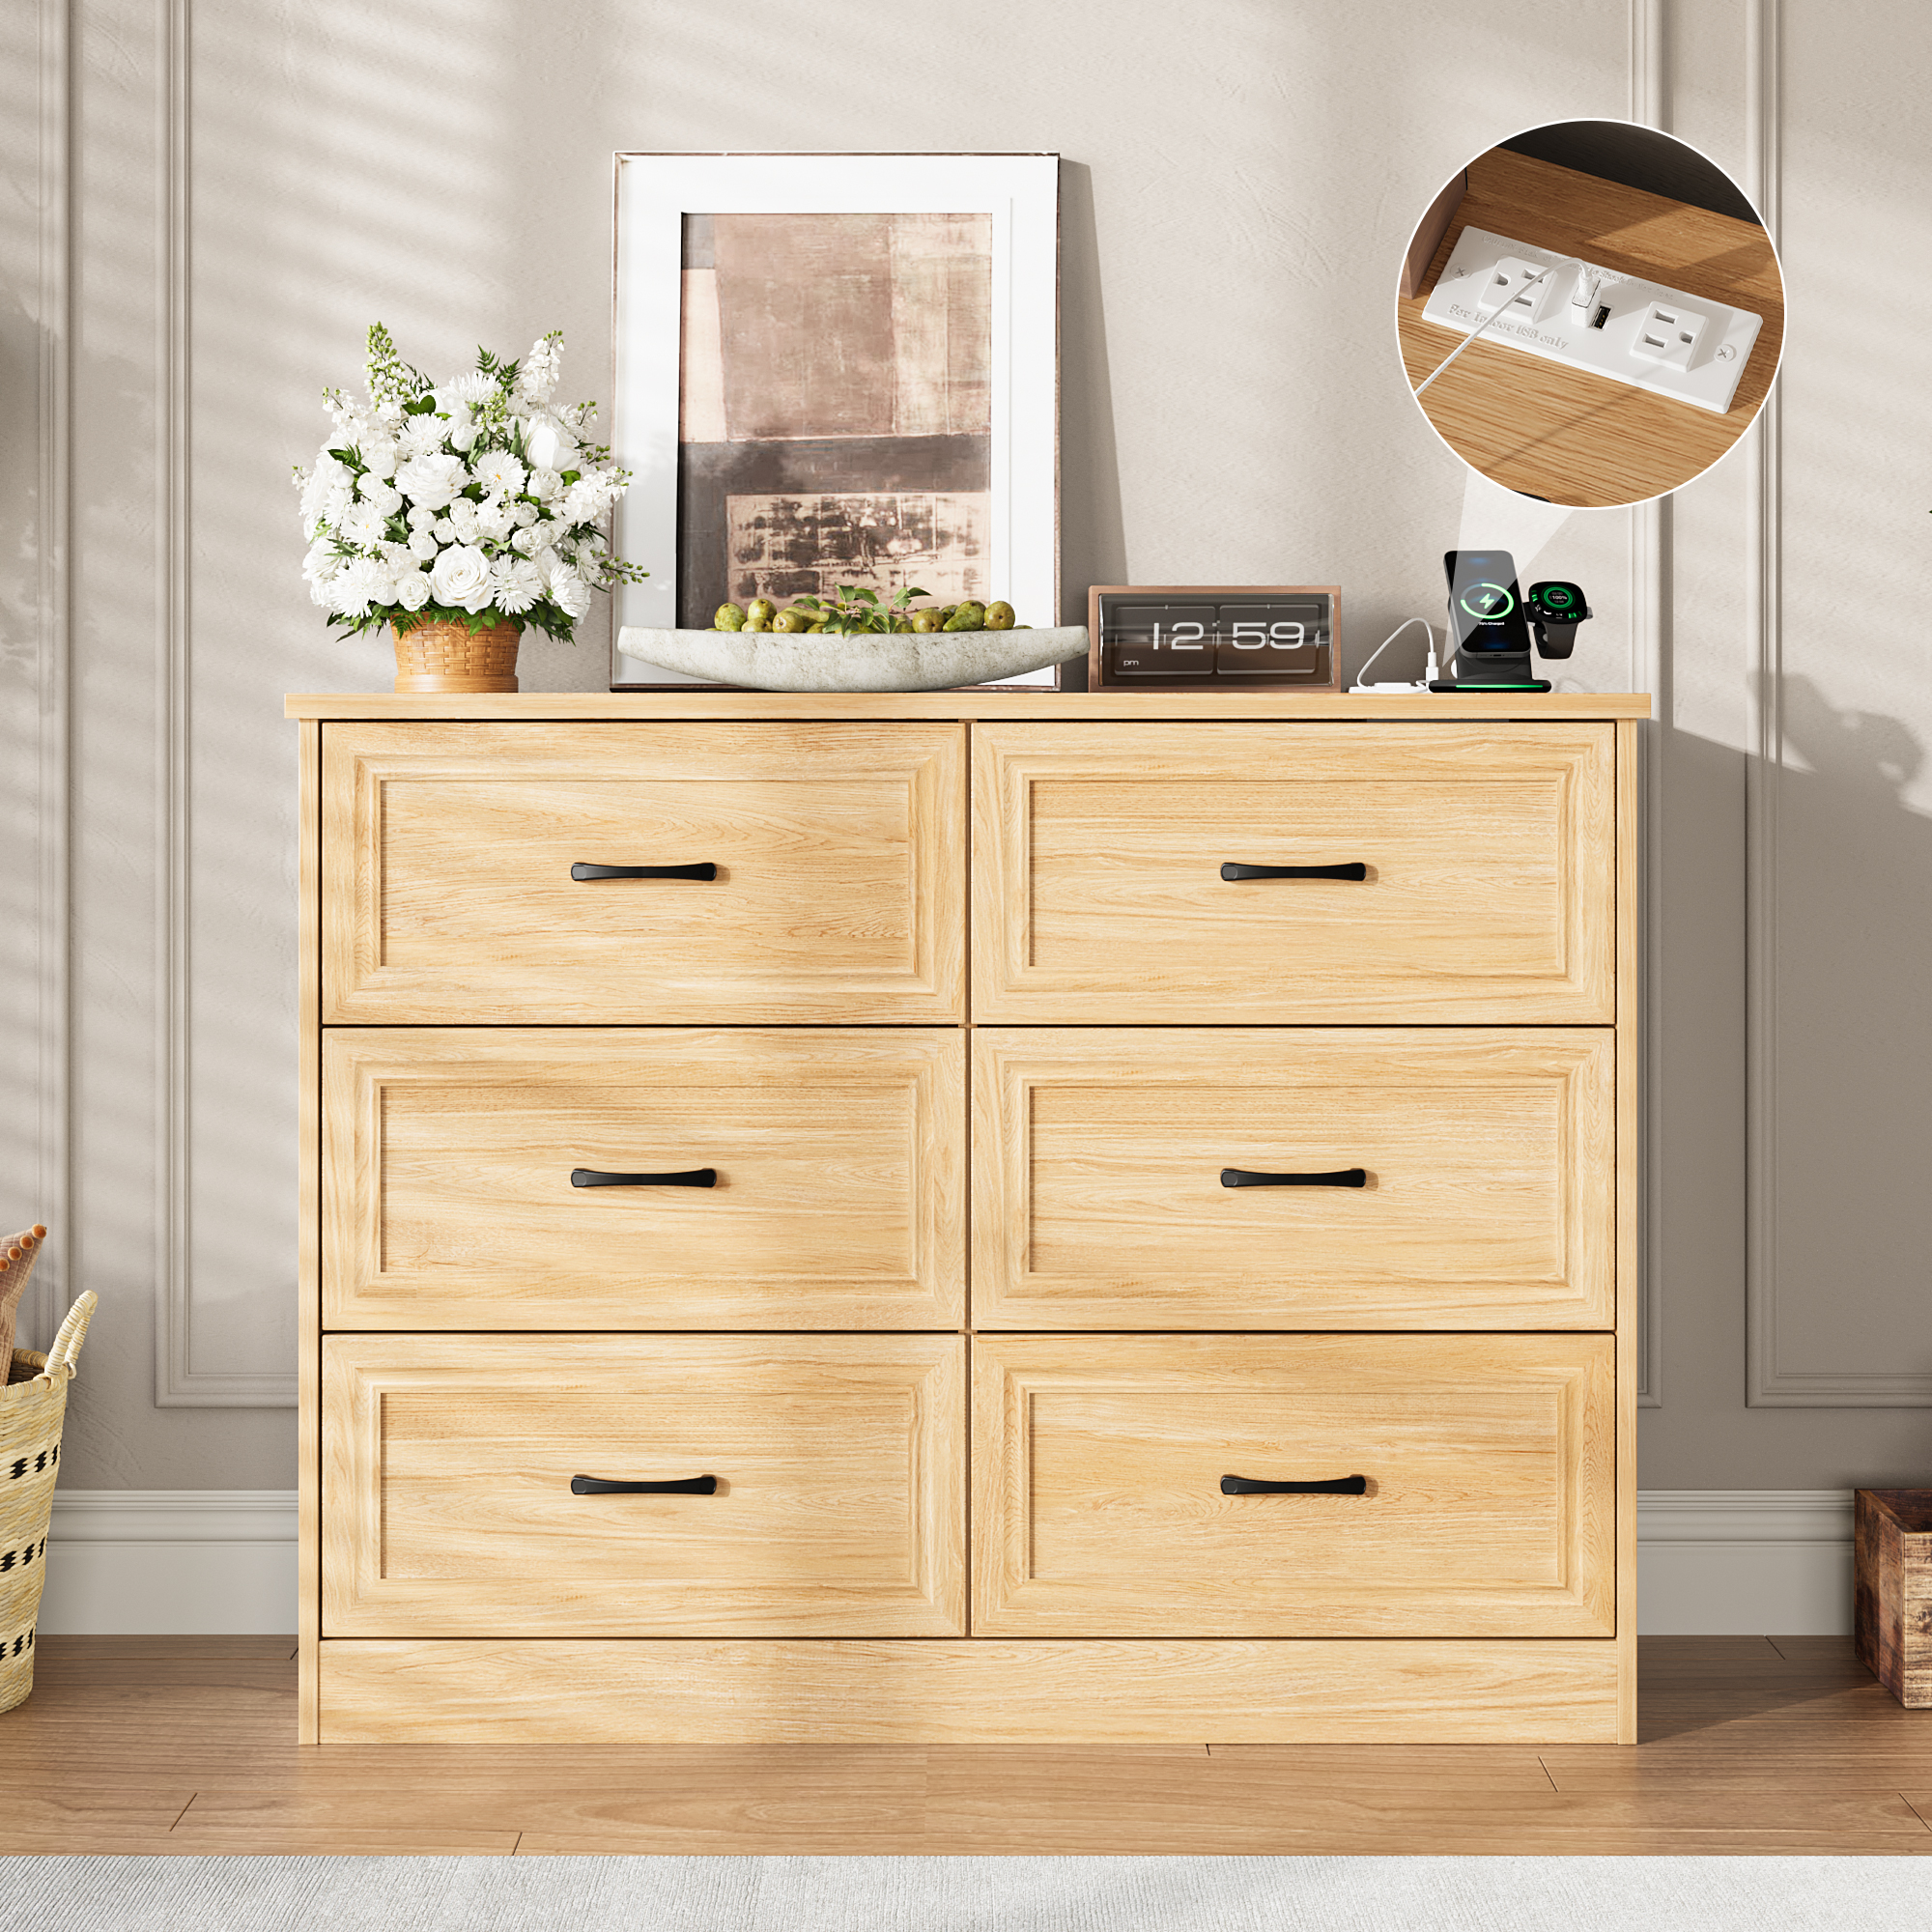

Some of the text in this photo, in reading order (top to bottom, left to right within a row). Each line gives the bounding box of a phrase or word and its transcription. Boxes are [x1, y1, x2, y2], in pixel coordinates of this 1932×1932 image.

[1471, 311, 1515, 332] Inoor
[1515, 325, 1540, 340] USB
[1539, 334, 1569, 351] only
[1152, 622, 1305, 650] 12 59
